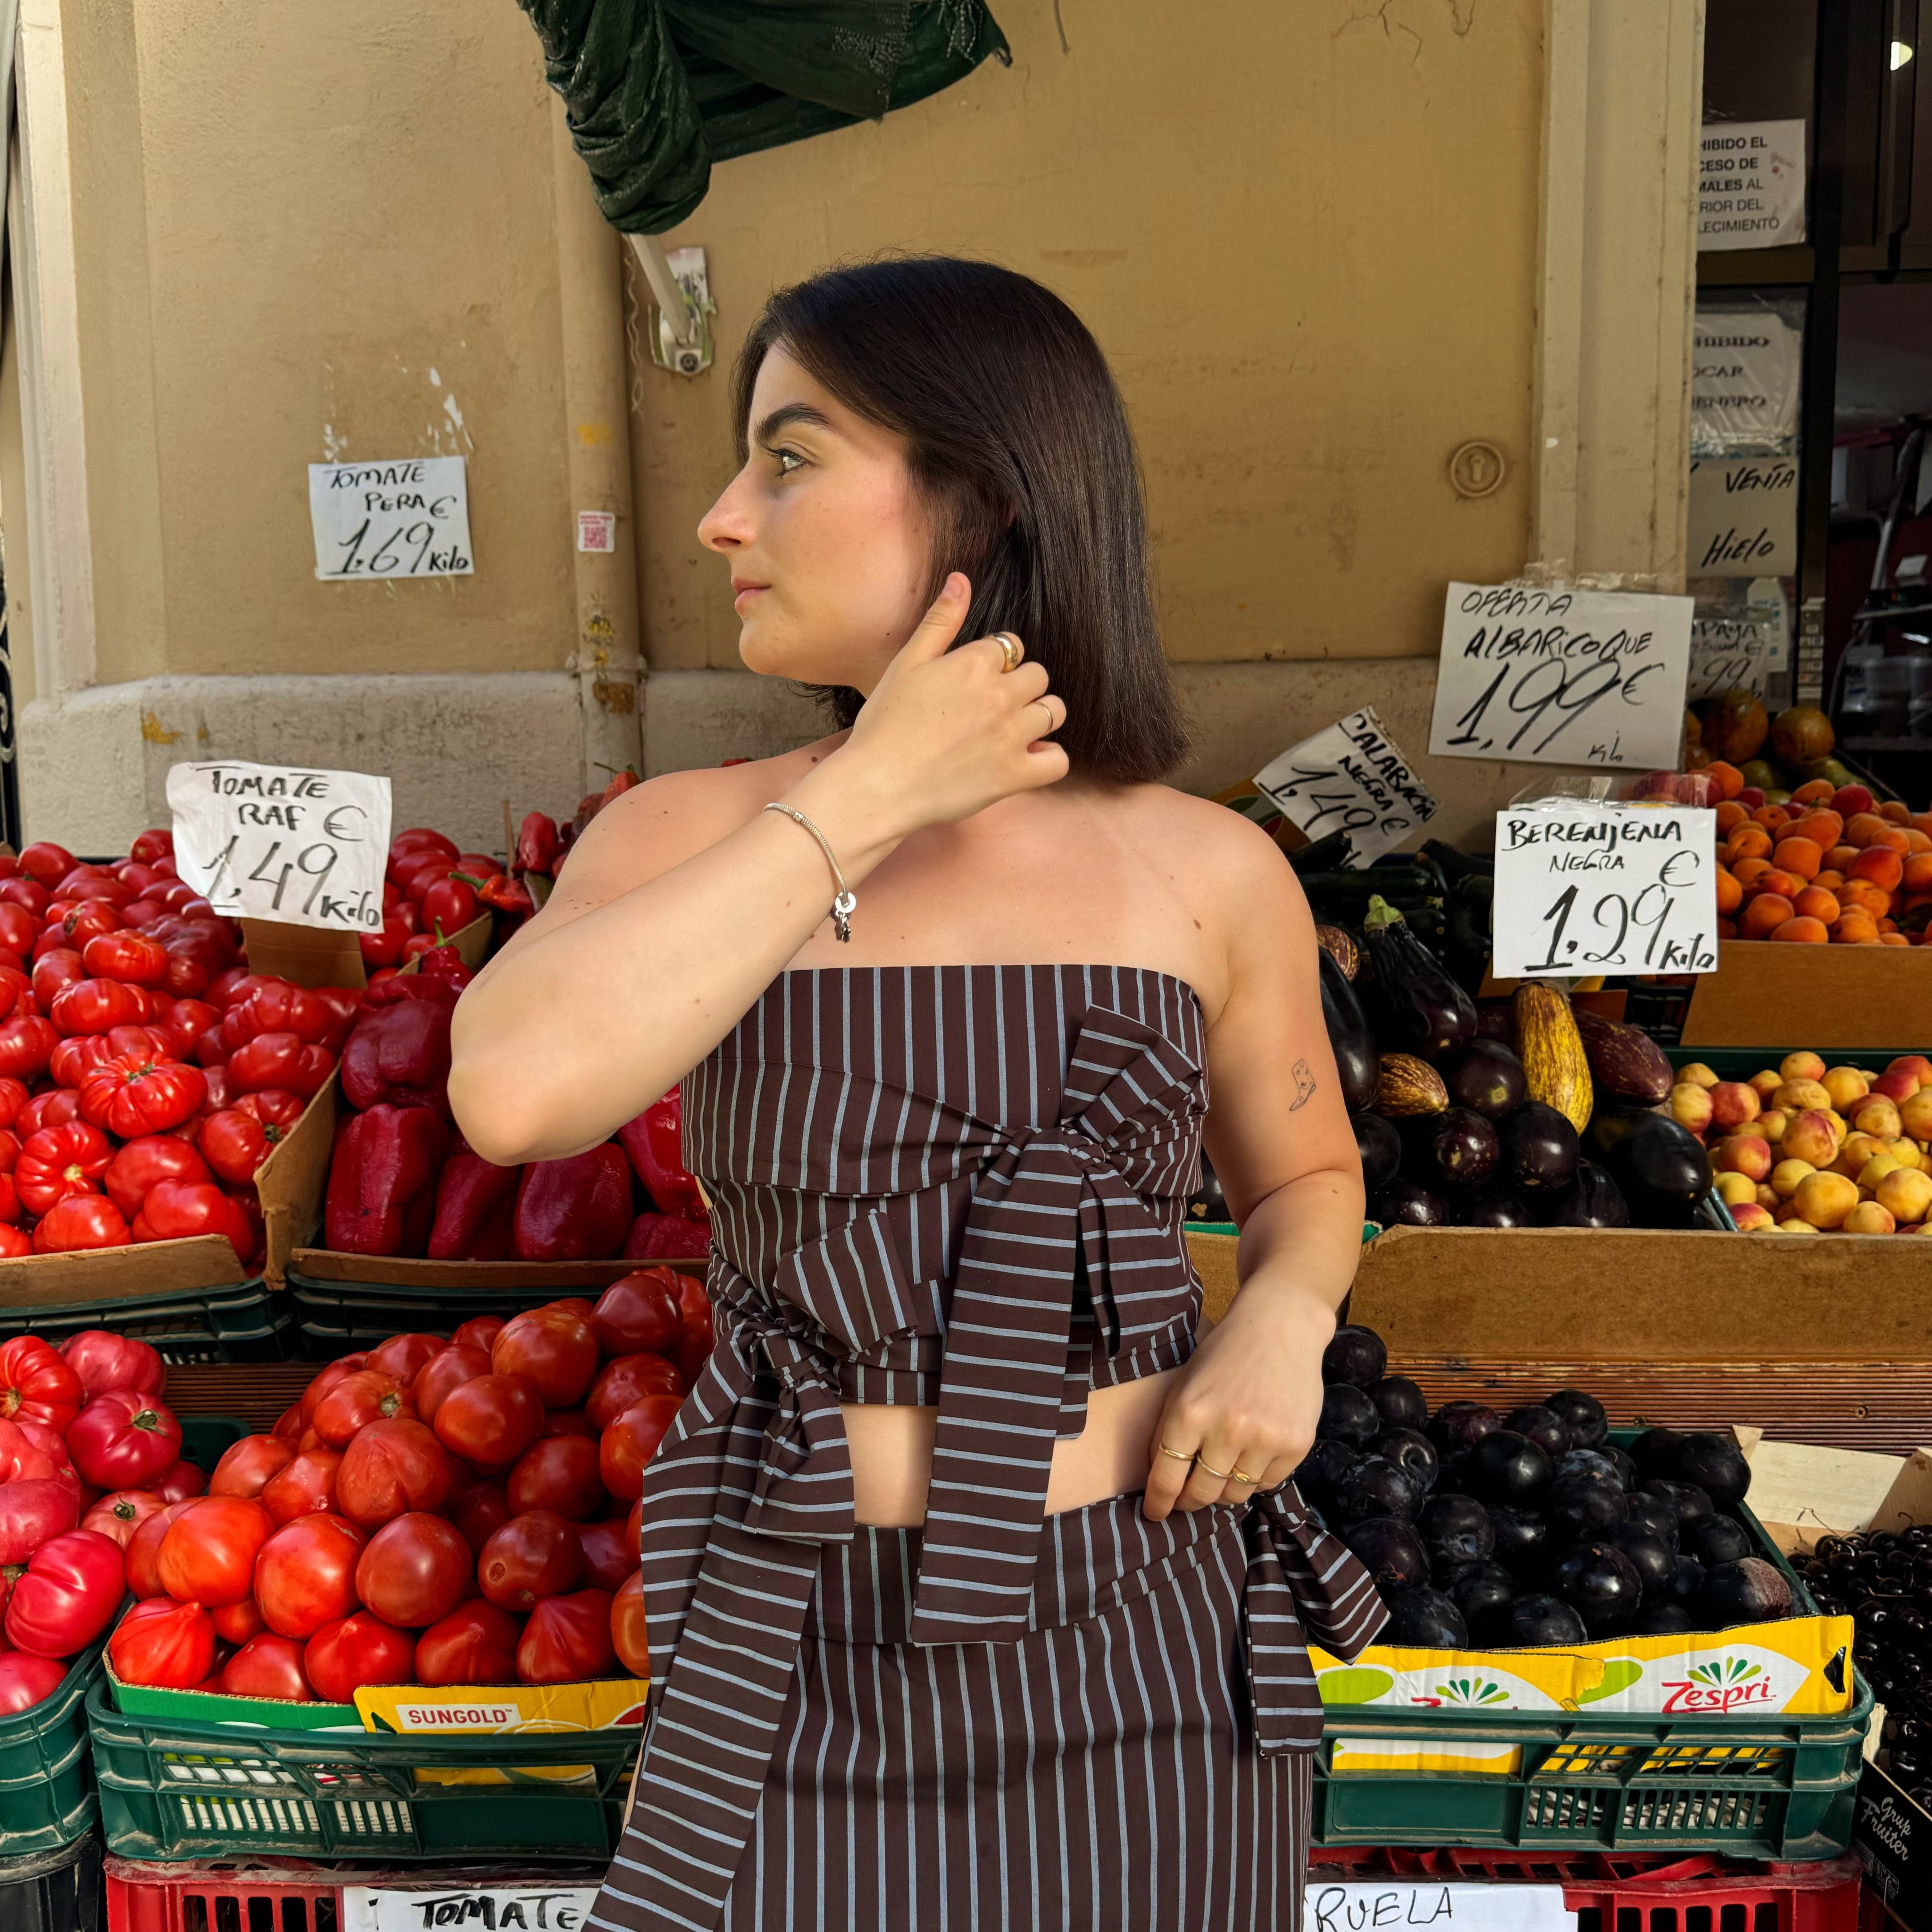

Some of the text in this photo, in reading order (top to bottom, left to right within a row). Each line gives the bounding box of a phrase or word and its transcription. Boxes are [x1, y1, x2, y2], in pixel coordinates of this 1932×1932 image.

[1750, 136, 1768, 148] EL
[1739, 157, 1758, 170] DE
[1746, 177, 1764, 189] AL
[1737, 198, 1763, 211] DEL
[1695, 336, 1770, 348] HIBIDO
[325, 462, 426, 489] TOMATE
[1725, 463, 1795, 492] VENTA
[365, 491, 457, 519] PERA €
[1461, 589, 1572, 617] OFERTA
[196, 766, 330, 798] TOMATE
[1338, 755, 1393, 811] NEGRA
[239, 803, 368, 842] RAF €
[1549, 849, 1699, 887] NEGRA €
[1661, 1675, 1771, 1714] Zespri
[1861, 1795, 1909, 1861] Fruiter
[1881, 1797, 1911, 1838] Grup
[411, 1893, 583, 1931] TOMATE
[1304, 1886, 1454, 1932] RUELA
